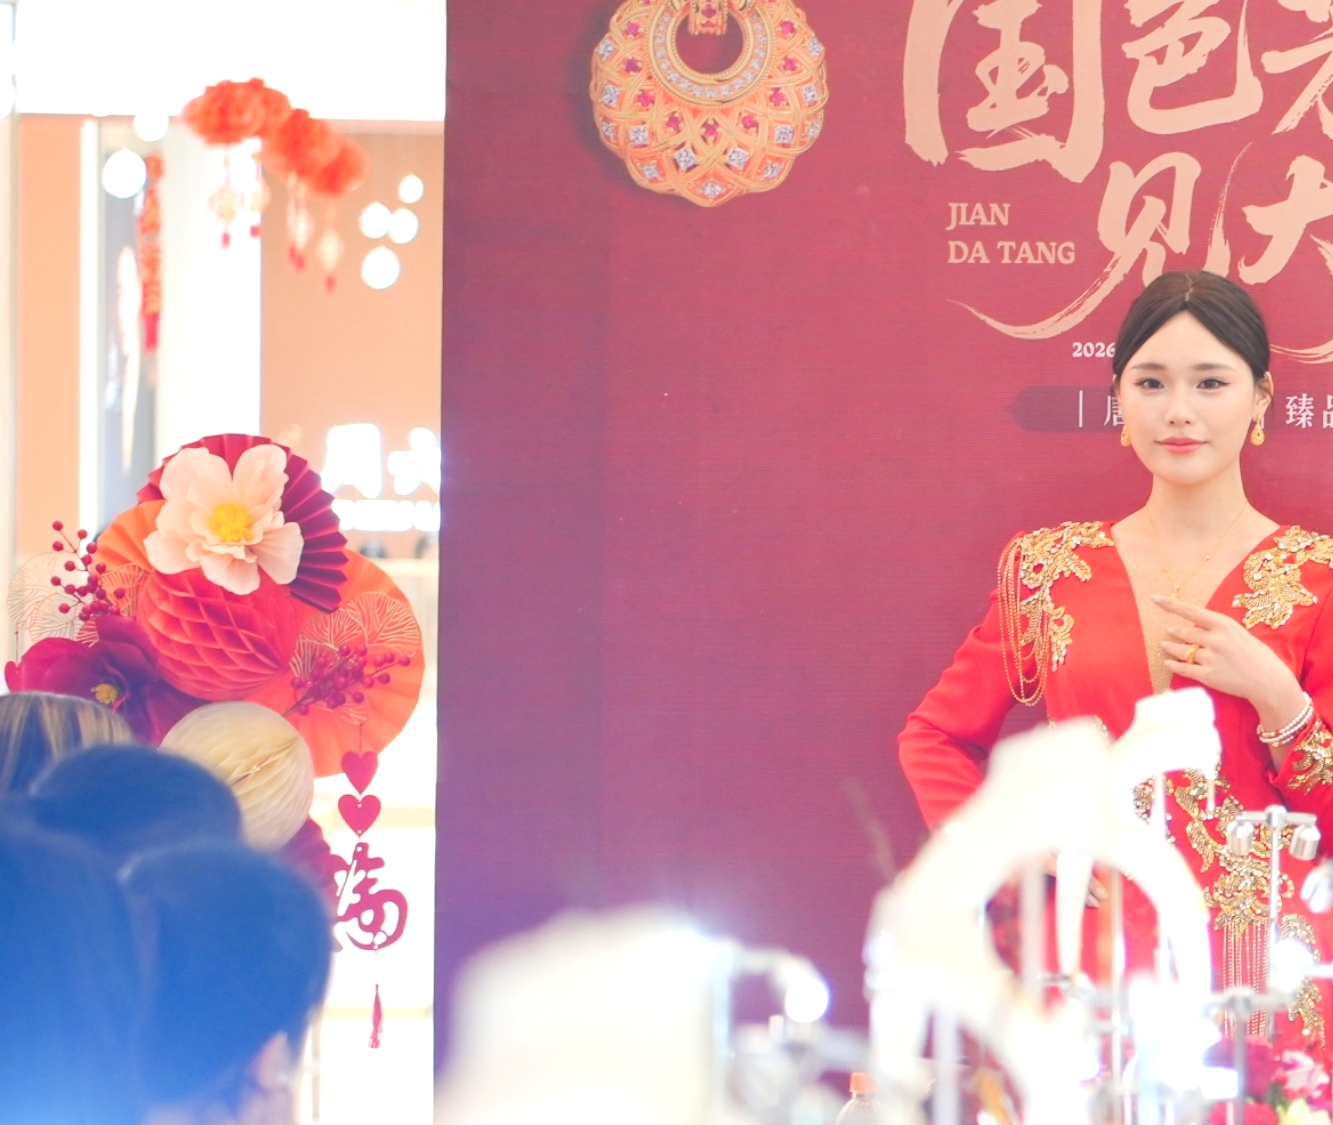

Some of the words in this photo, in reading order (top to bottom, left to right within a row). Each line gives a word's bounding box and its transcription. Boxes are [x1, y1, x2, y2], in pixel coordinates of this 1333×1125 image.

[945, 202, 1010, 231] JIAN
[948, 241, 990, 264] DA
[998, 241, 1076, 265] TANG
